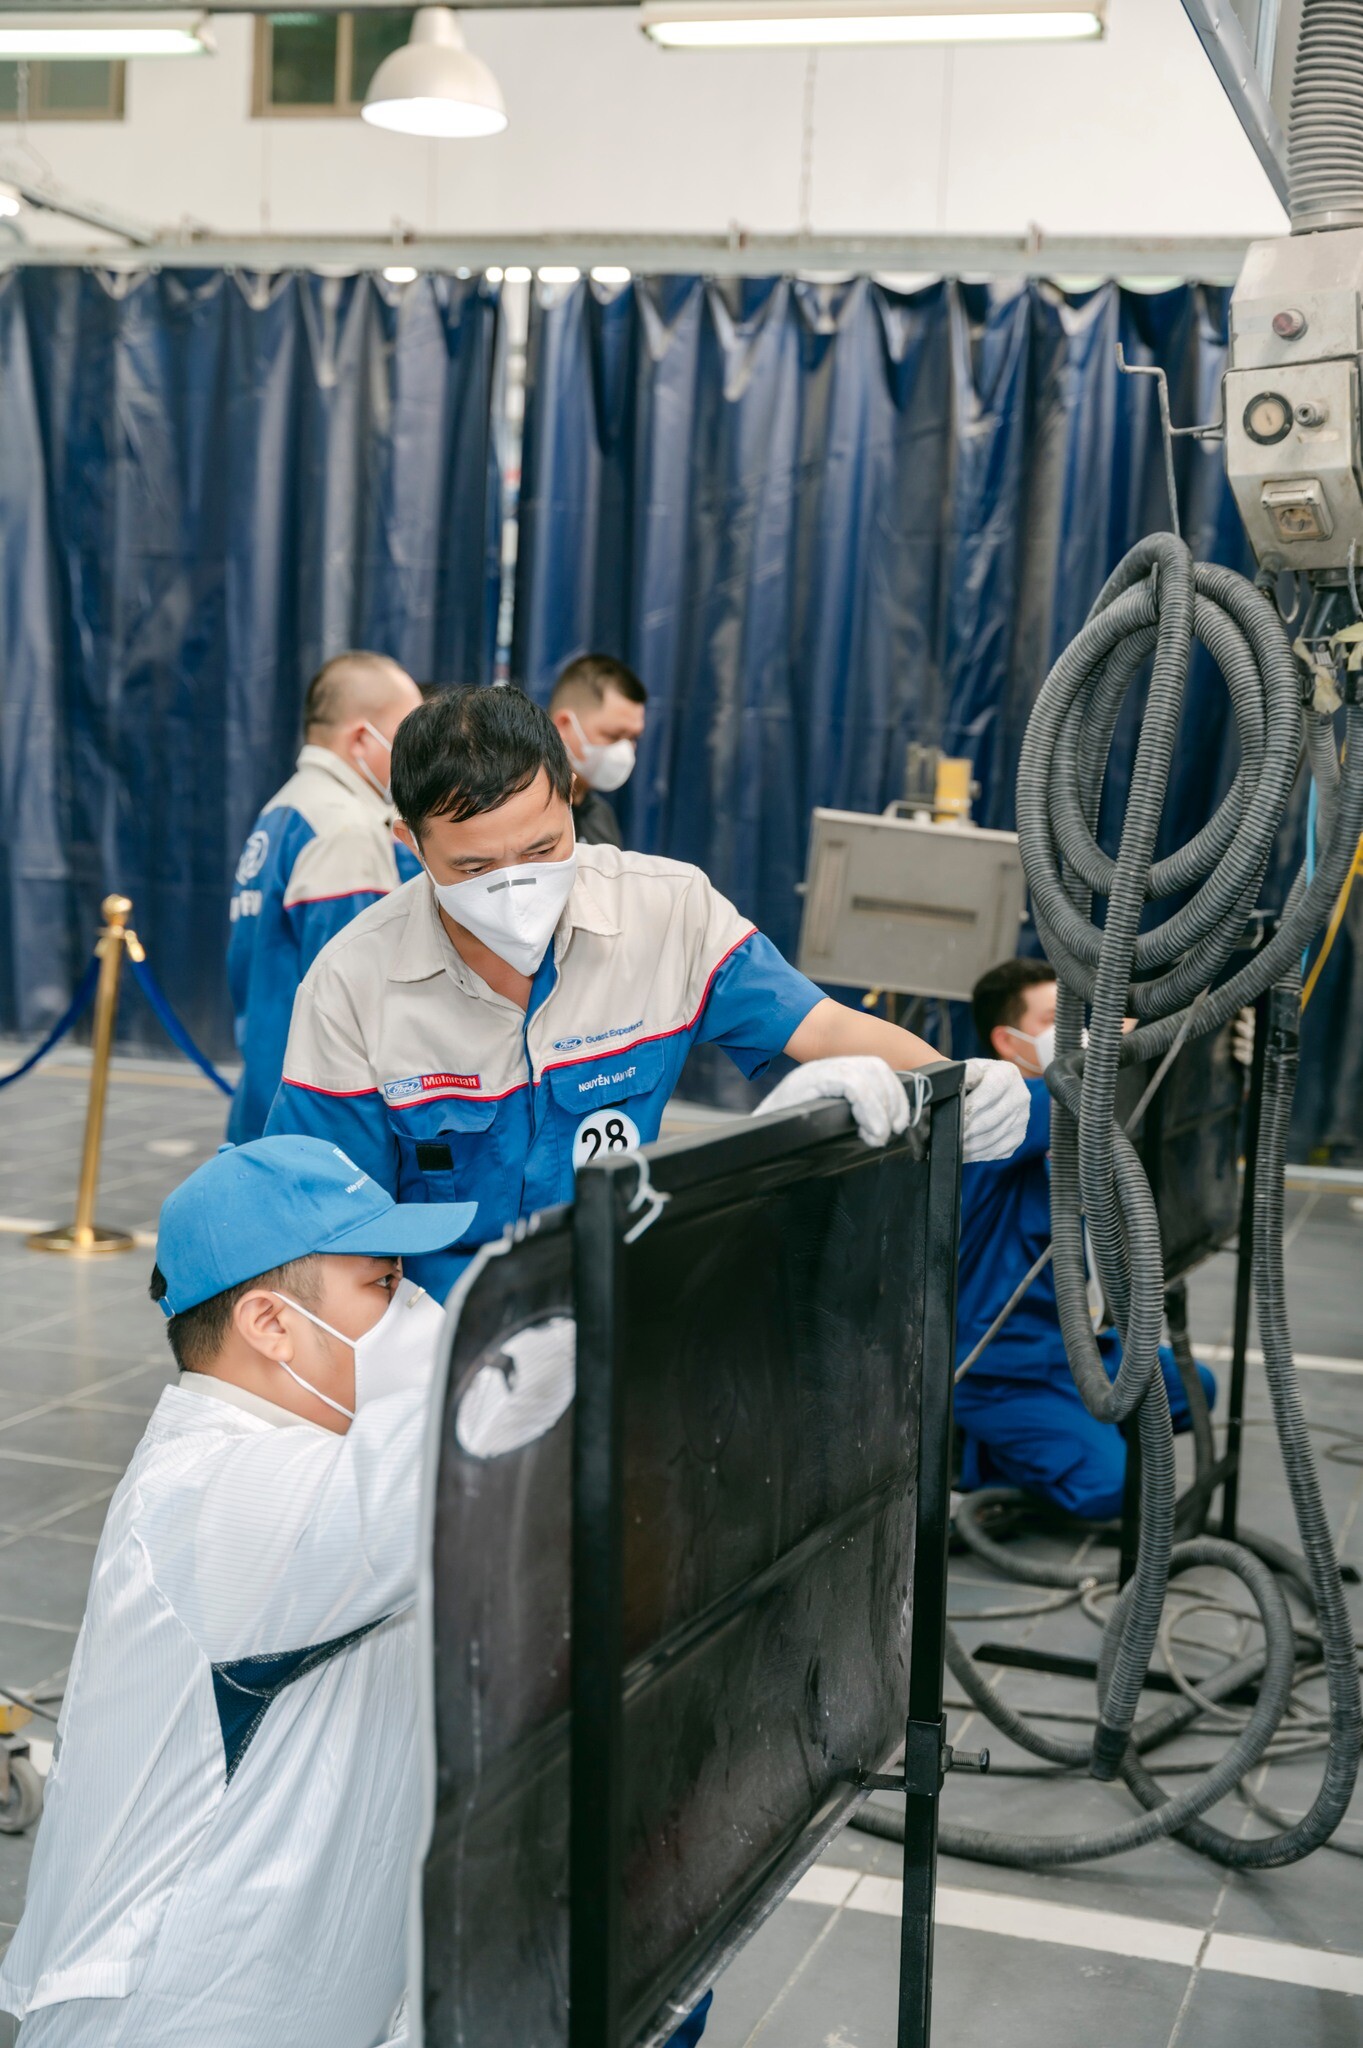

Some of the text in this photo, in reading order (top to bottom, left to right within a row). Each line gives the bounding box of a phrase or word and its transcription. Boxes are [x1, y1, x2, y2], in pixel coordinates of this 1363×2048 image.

[585, 1032, 609, 1044] Guest
[609, 1019, 643, 1036] Experienc
[391, 1075, 478, 1095] Ford Motorcraft
[581, 1118, 628, 1166] 28
